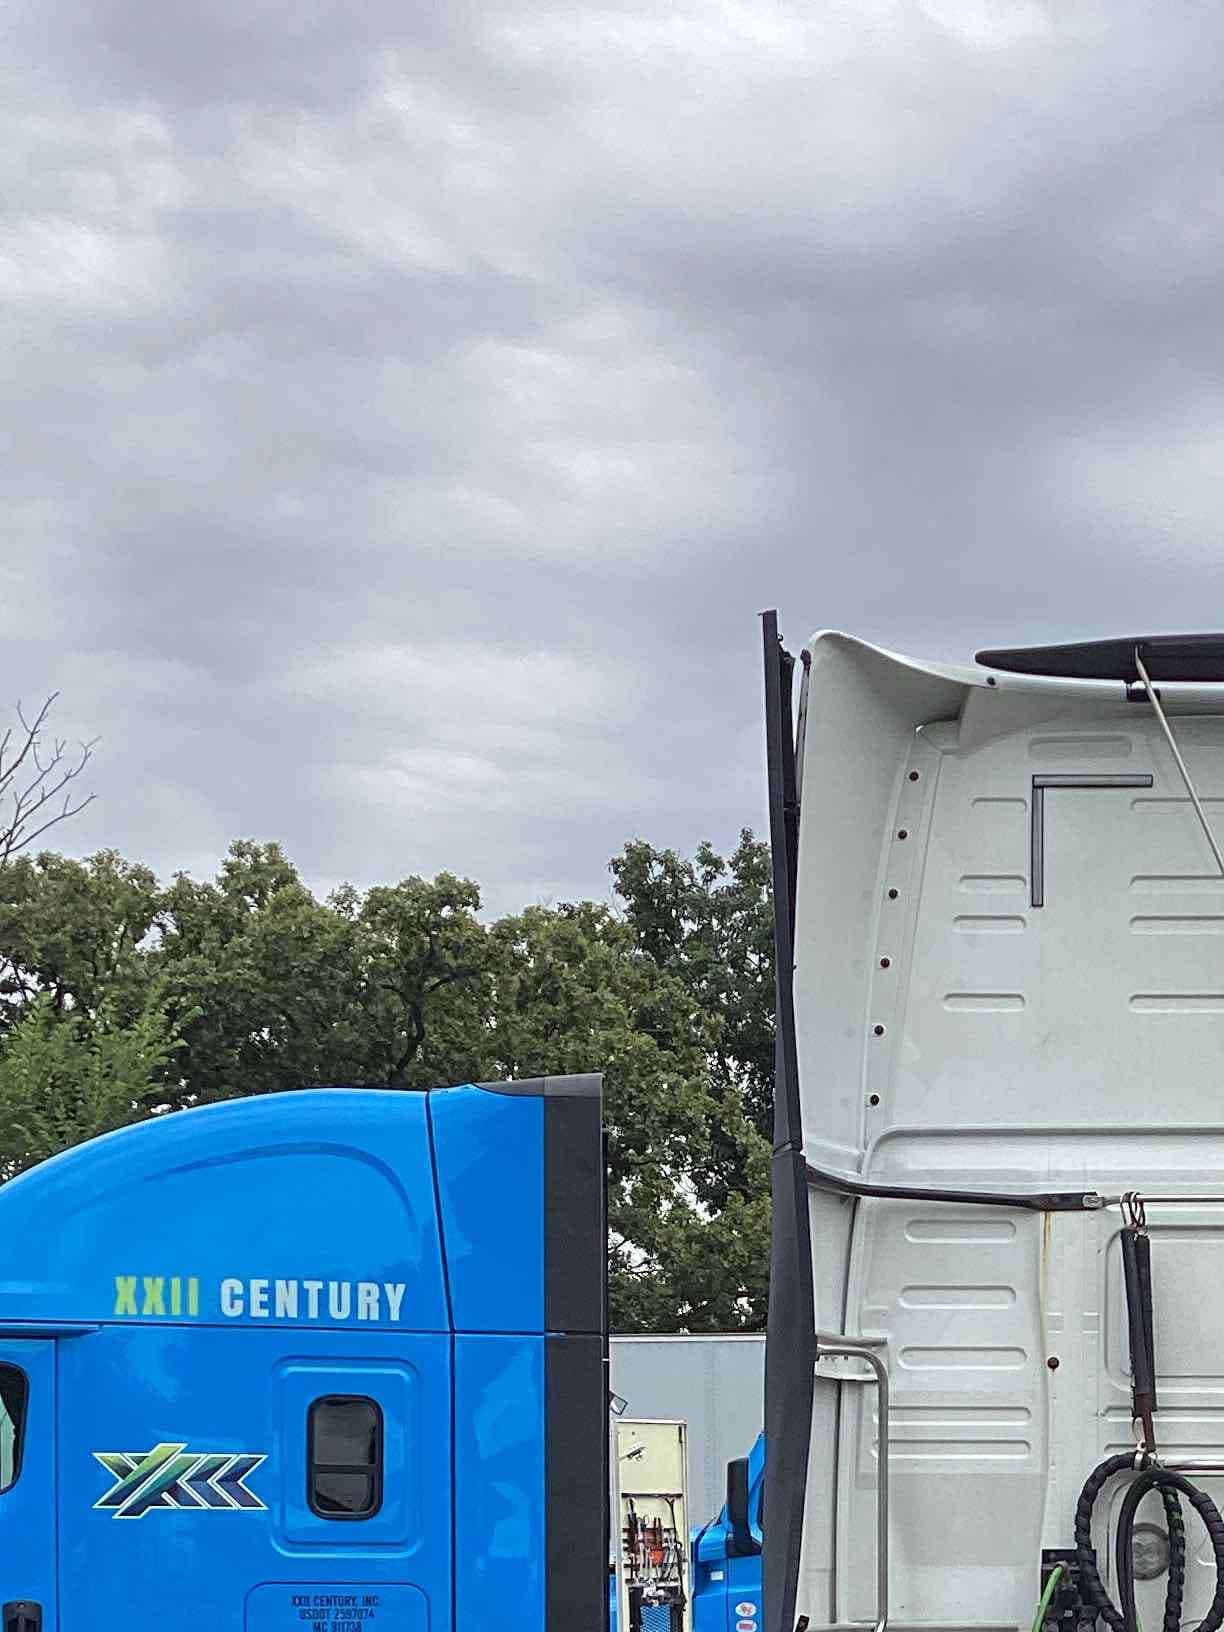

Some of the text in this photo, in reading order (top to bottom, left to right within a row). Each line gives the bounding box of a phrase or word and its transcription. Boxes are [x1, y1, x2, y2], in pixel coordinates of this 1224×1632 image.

[114, 1275, 407, 1322] XXII CENTURY
[312, 1620, 329, 1632] MC
